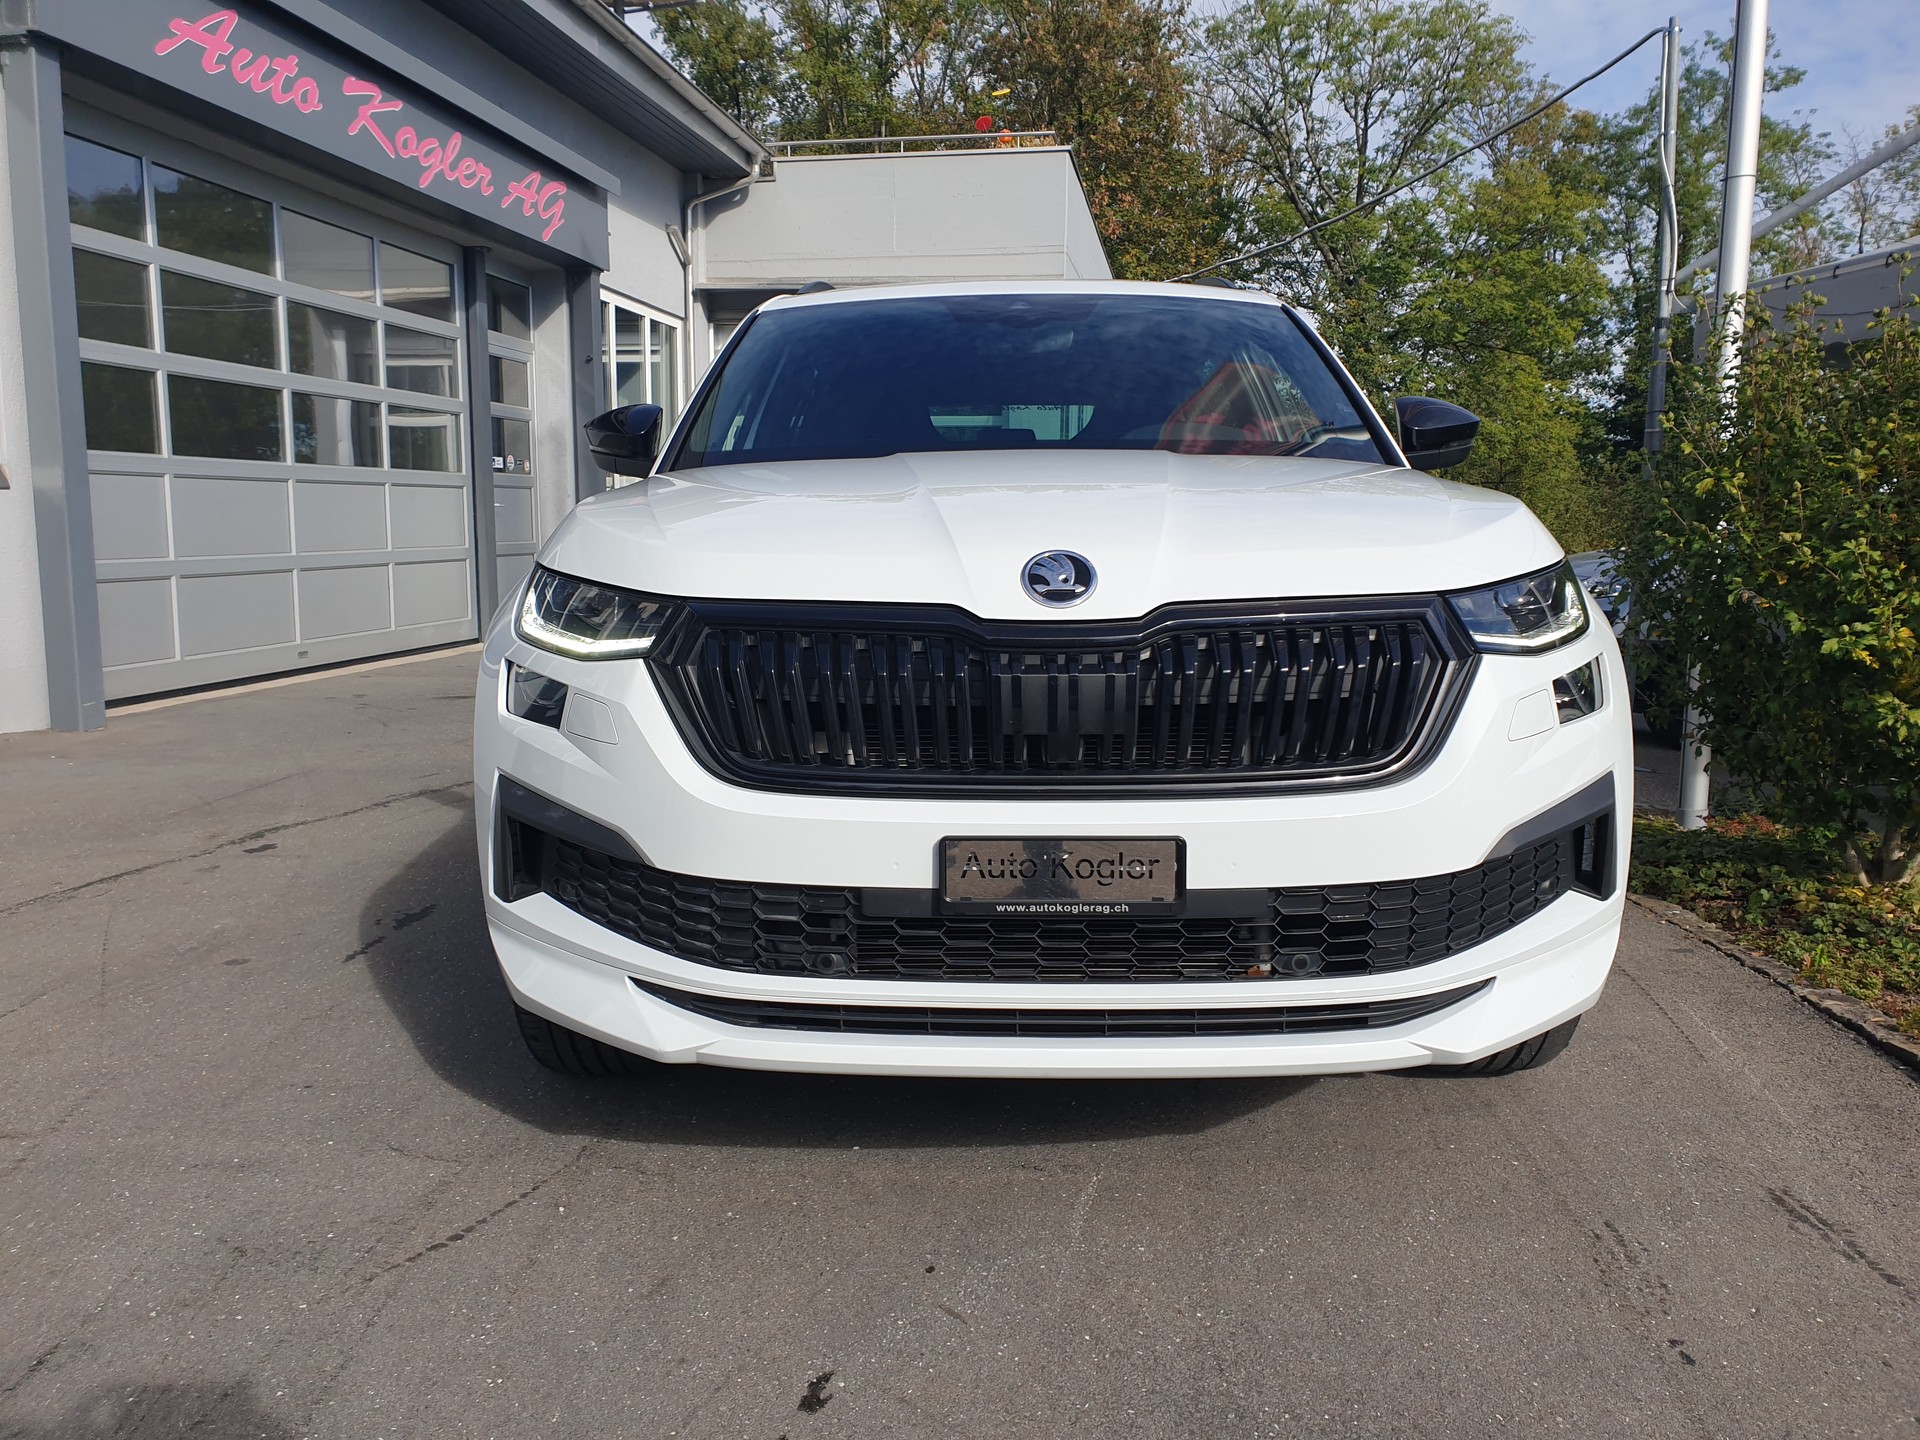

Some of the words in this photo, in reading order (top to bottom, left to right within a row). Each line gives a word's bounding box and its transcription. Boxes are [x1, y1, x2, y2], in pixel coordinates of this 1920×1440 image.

[154, 9, 323, 114] Auto
[342, 76, 495, 196] Kogler
[501, 171, 568, 241] AG
[961, 851, 1038, 879] Auto
[1051, 851, 1160, 886] Kogler
[996, 903, 1129, 914] www.autokoglerag.ch
